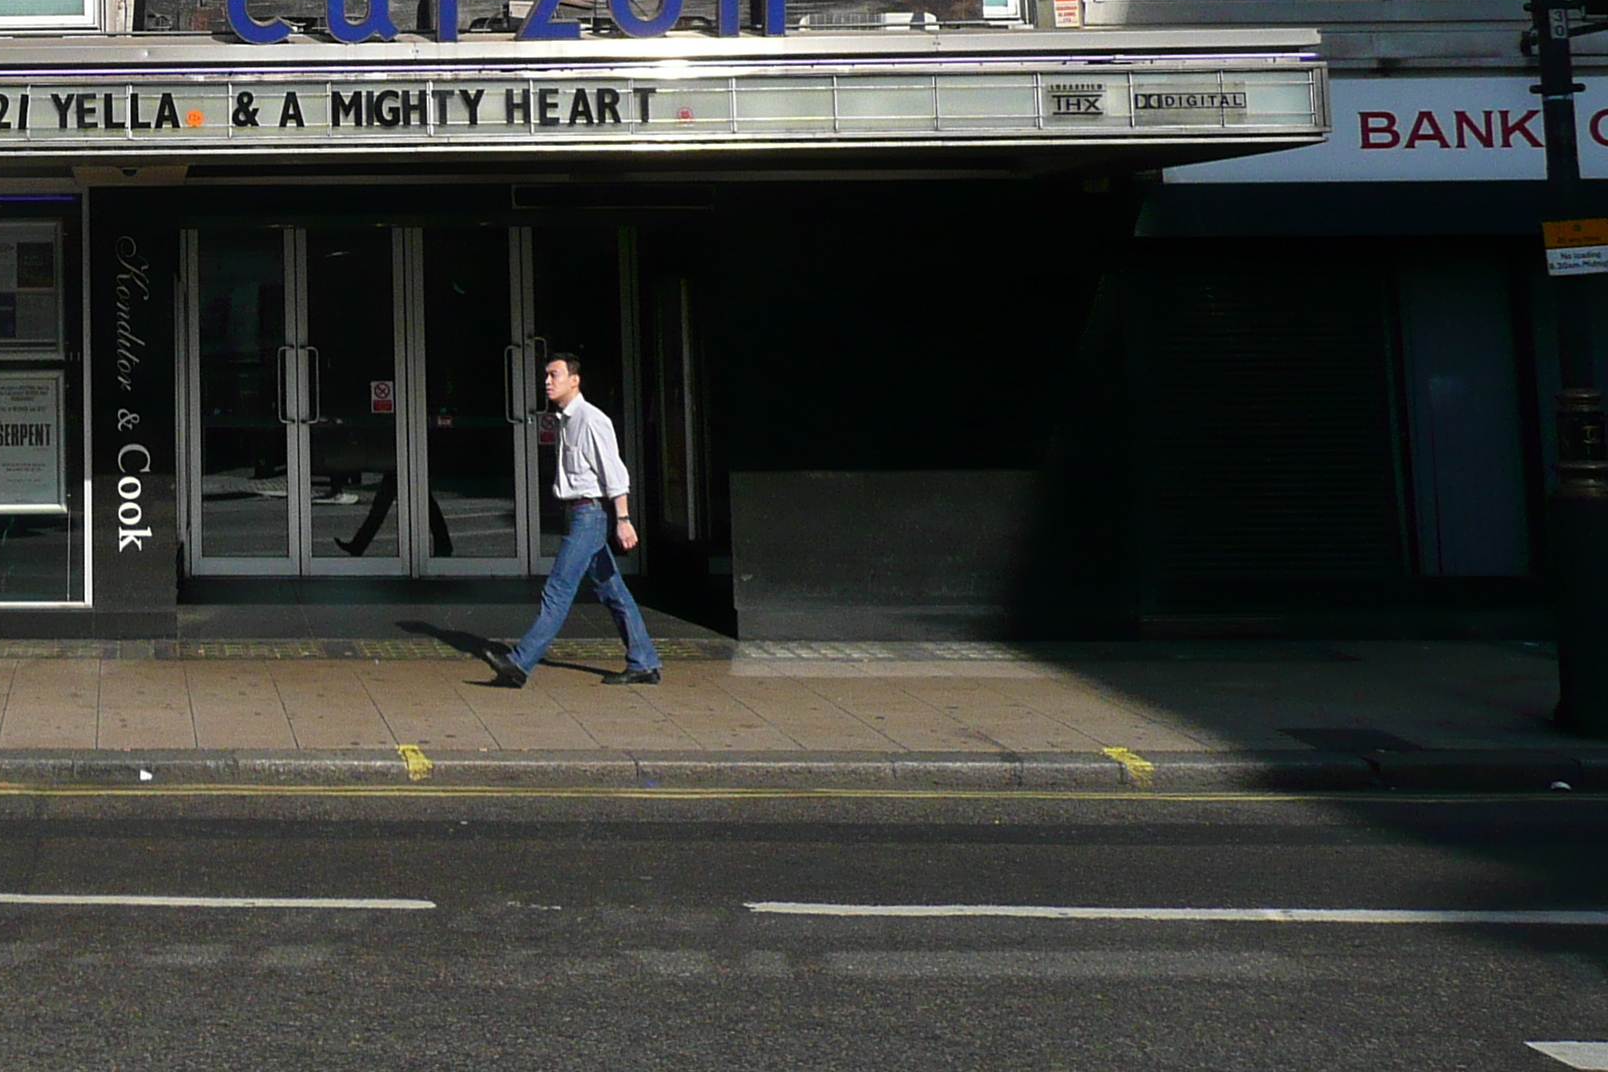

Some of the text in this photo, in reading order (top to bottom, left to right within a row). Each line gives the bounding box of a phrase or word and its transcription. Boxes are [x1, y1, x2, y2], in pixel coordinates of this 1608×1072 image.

[50, 91, 182, 131] YELLA
[231, 90, 260, 128] &
[279, 90, 305, 128] A
[331, 88, 486, 127] MIGHTY
[506, 87, 658, 125] HEART
[1052, 94, 1103, 112] THX
[1166, 94, 1243, 107] DIGITAL
[1358, 109, 1545, 149] BANK
[115, 235, 152, 552] Konditor & Cook
